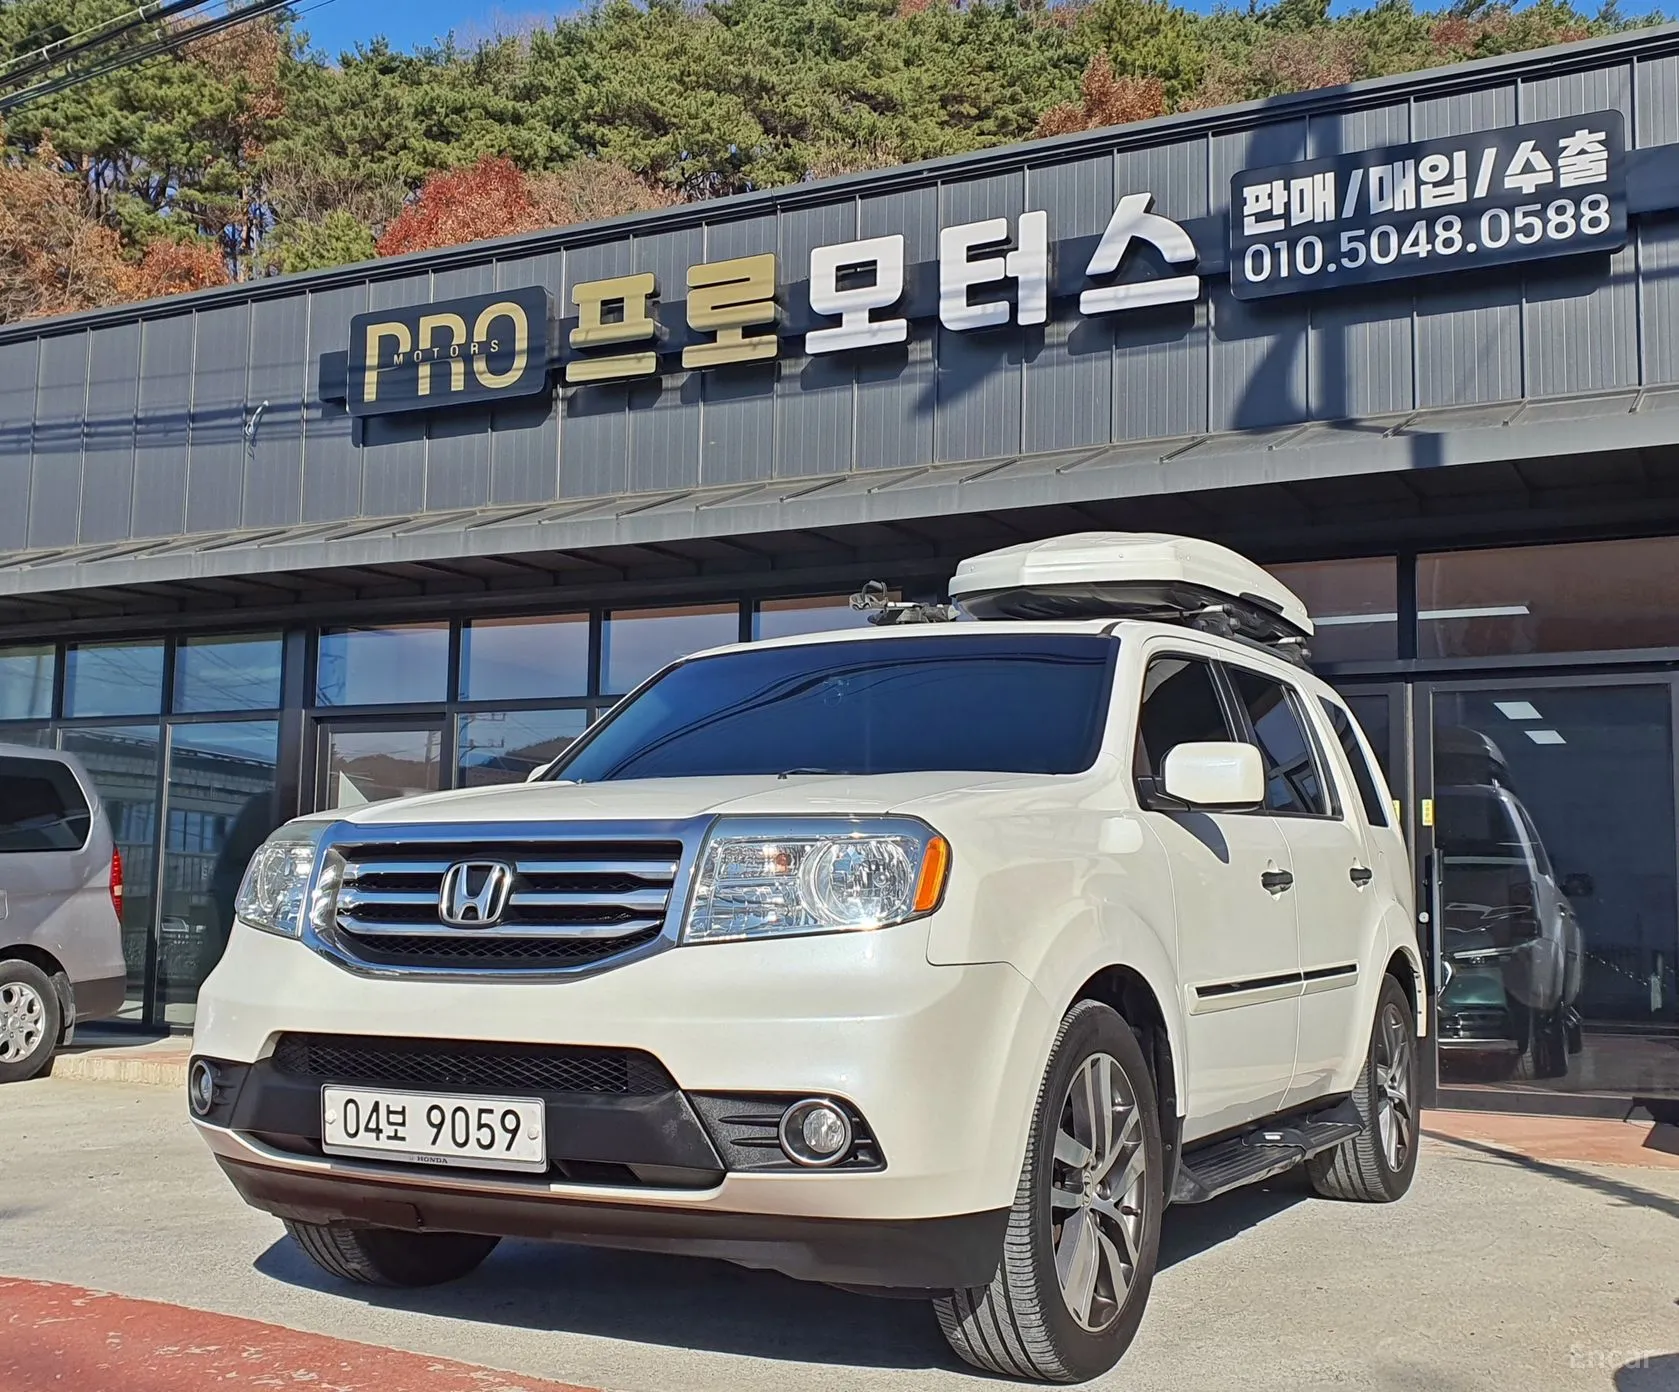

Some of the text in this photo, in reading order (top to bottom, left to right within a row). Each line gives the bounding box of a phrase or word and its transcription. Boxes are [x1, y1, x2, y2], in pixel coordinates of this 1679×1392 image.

[1243, 193, 1612, 283] 010.5048.0588
[363, 301, 529, 403] PRO
[393, 339, 500, 366] MOTORS
[342, 1097, 522, 1152] 04보 9059
[416, 1155, 449, 1165] HONDA
